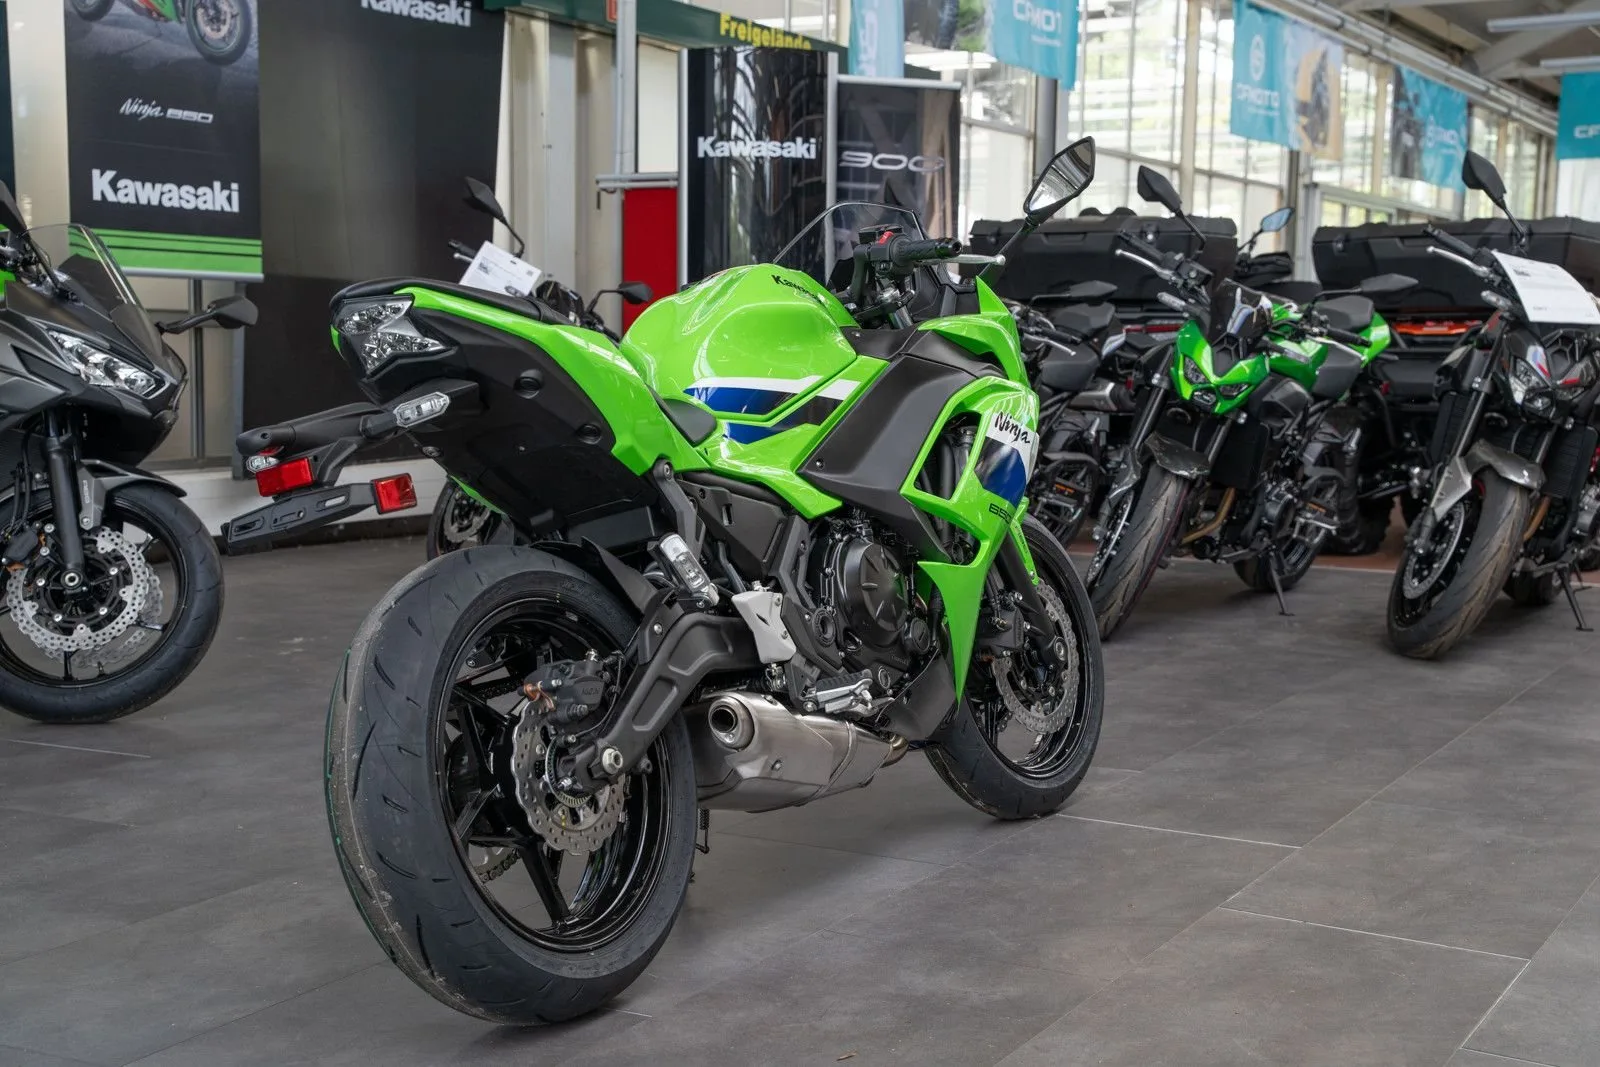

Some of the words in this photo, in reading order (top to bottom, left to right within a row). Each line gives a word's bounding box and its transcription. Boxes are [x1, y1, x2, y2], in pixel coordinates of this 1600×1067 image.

[119, 98, 164, 121] Ninja
[697, 136, 817, 160] Kawasaki
[840, 150, 945, 173] 900
[92, 168, 240, 213] Kawasaki
[994, 411, 1031, 444] Ninja
